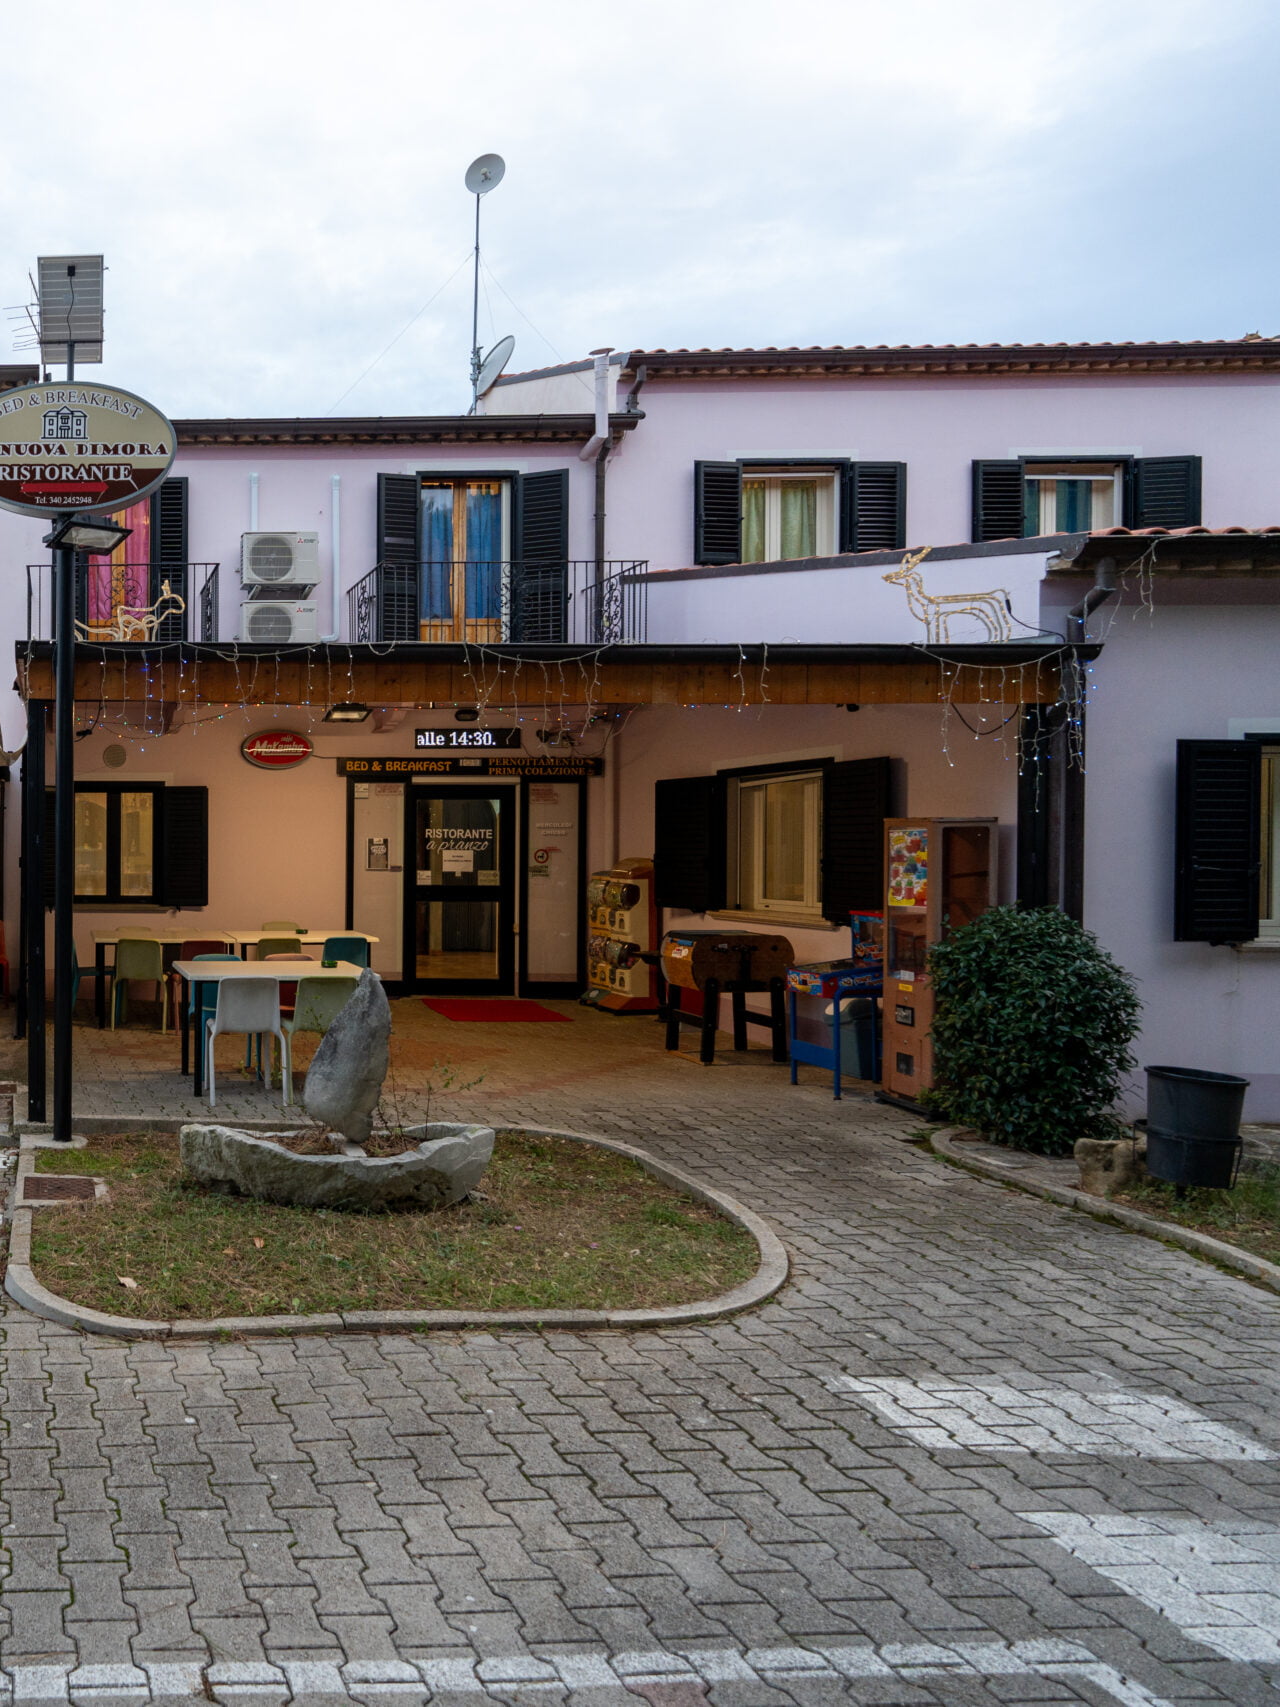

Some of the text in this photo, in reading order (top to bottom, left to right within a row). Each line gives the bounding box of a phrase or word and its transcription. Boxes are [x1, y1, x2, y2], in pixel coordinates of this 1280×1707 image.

[29, 393, 40, 406] &
[45, 391, 143, 419] BREAKFAST
[0, 443, 68, 456] NUOVA
[75, 443, 169, 456] DIMORA
[35, 496, 93, 504] Tel. 340 2452948
[417, 731, 497, 746] alle 14:30.
[346, 761, 453, 772] BED & BREAKFAST
[488, 758, 585, 766] PERNOTTAMENTO
[488, 767, 585, 776] PRIMA COLAZIONE
[425, 828, 493, 839] RISTORANTE
[426, 840, 489, 855] a pranzo
